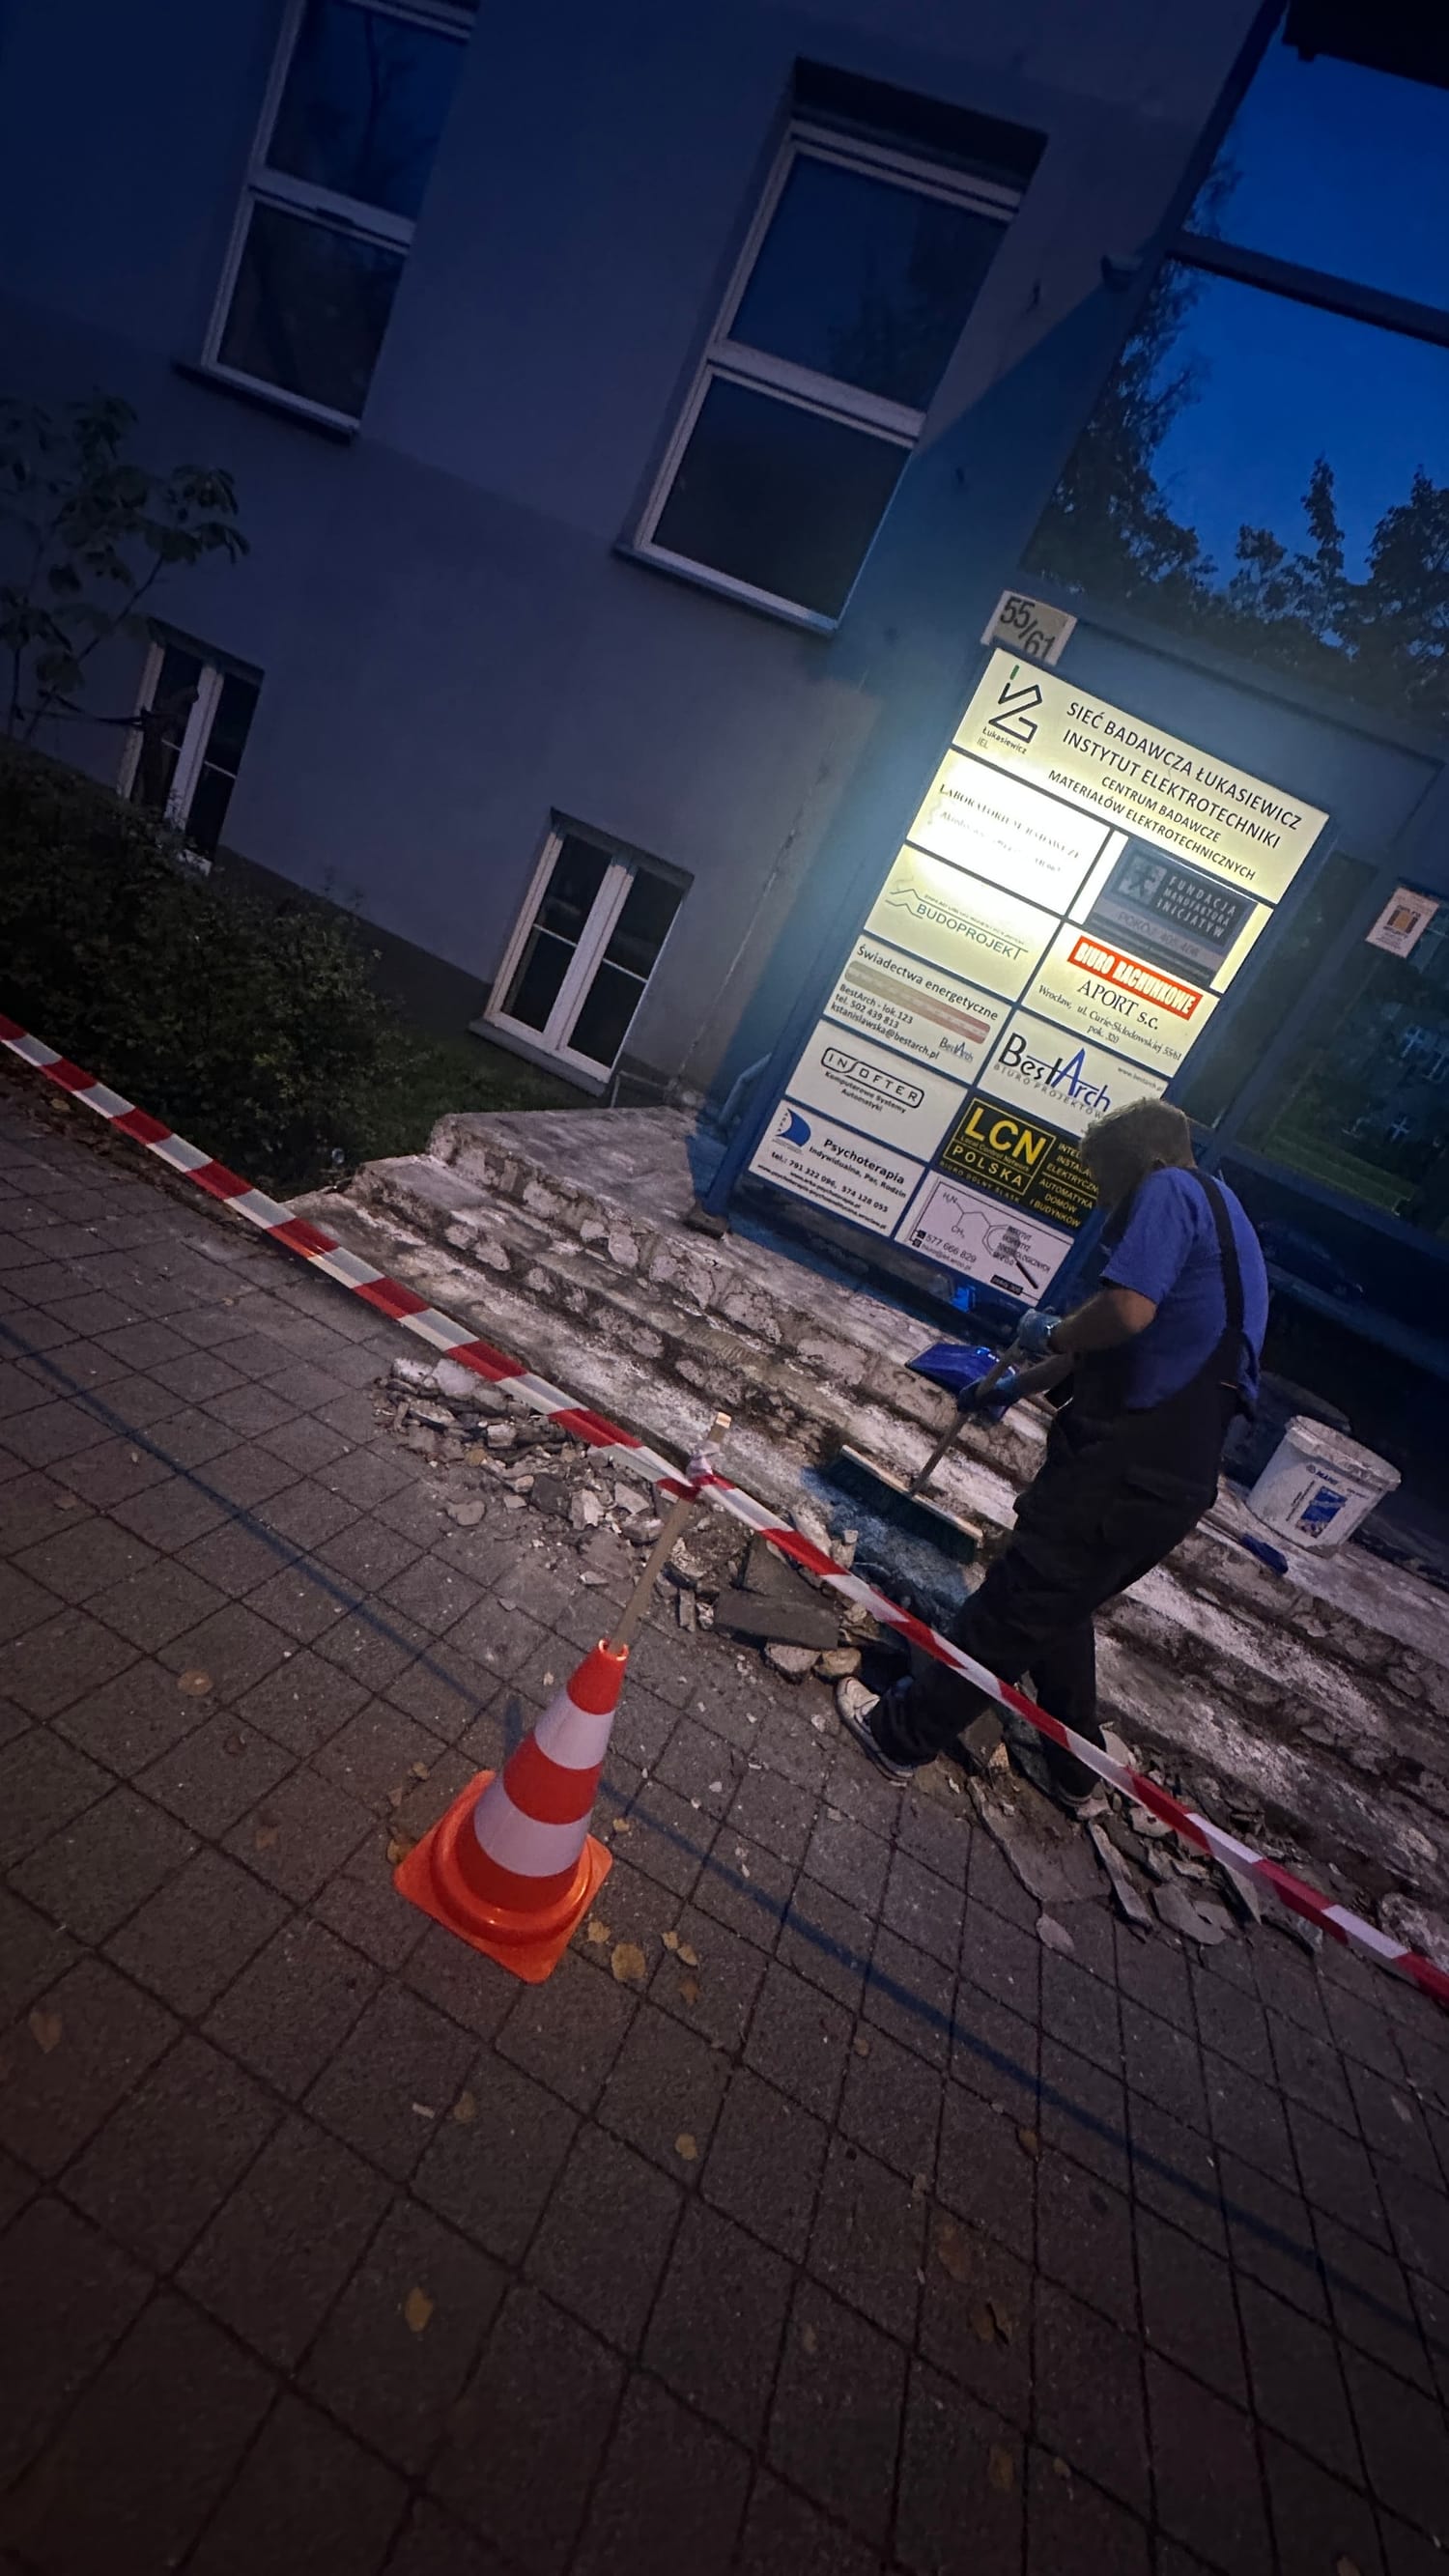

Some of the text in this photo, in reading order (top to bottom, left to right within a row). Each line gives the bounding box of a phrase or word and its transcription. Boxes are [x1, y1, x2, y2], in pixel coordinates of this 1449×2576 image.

[980, 725, 1029, 755] Łukasiewicz
[1065, 696, 1303, 831] SIEĆ BADAWCZA ŁUKASIEWICZ
[1062, 728, 1283, 849] INSTYTUT ELEKTROTECHNIKI
[1099, 775, 1222, 843] CENTRUM BADAWCZE
[1046, 767, 1127, 815] MATERIAŁÓW
[1123, 807, 1258, 881] ELEKTROTECHNICZNYCH
[1154, 896, 1226, 939] INICJATYW
[1167, 874, 1238, 917] FUNDACJA
[915, 899, 1022, 961] BUDOPROJEKT
[838, 982, 877, 1007] BestArch
[856, 942, 999, 1023] Świadectwa energetyczne
[1036, 983, 1075, 1010] Wrocław,
[1072, 941, 1117, 976] BIURO
[1110, 960, 1197, 1015] RACHUNKOWE
[834, 992, 900, 1030] tel. 502 439 813
[1075, 977, 1162, 1031] APORT s.c.
[1086, 1023, 1106, 1039] pok.
[992, 1062, 1032, 1086] BIURO
[997, 1032, 1111, 1113] BestArch
[963, 1105, 1047, 1166] LCN
[788, 1159, 804, 1172] 791
[804, 1167, 820, 1179] 322
[857, 1193, 873, 1204] 128
[808, 1146, 864, 1178] Indywidualna,
[879, 1179, 908, 1199] Rodzin
[821, 1137, 907, 1186] Psychoterapia
[951, 1144, 1025, 1187] POLSKA
[1044, 1162, 1100, 1194] ELEKTRYCZN
[1037, 1177, 1094, 1209] AUTOMATYKA
[924, 1233, 977, 1263] 577 666 829
